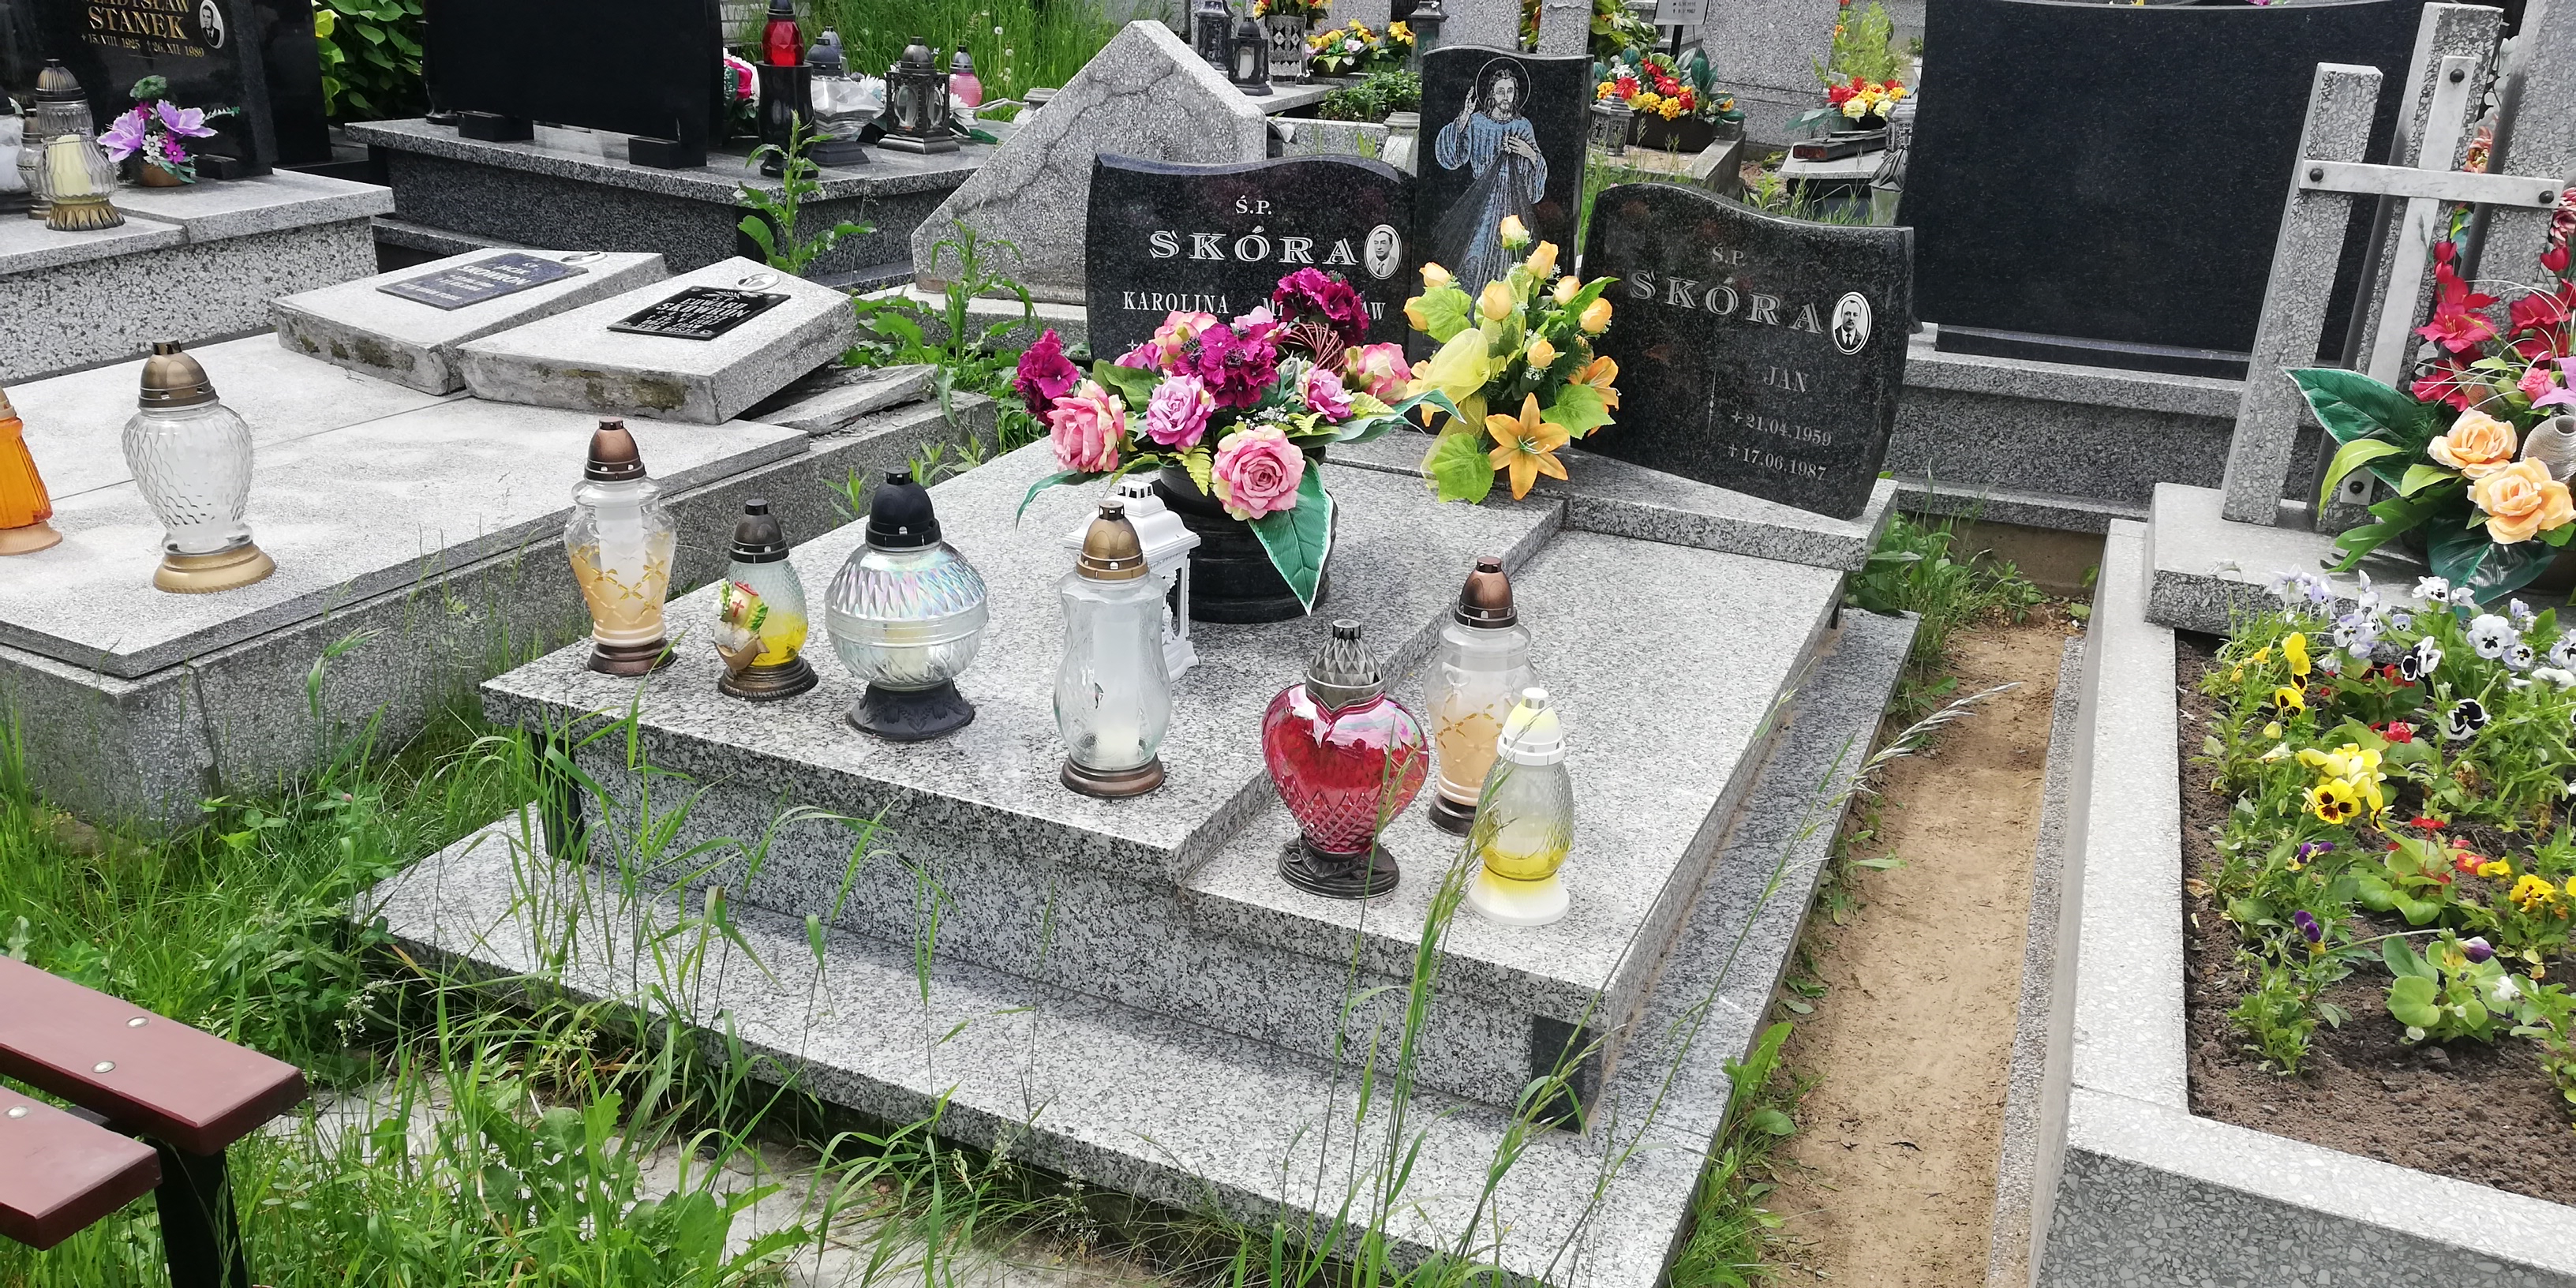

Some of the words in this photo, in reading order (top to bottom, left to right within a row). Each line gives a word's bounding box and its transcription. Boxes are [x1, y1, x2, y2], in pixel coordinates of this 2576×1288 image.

[88, 6, 188, 39] STANEK
[1235, 195, 1272, 215] Ś.P.
[1149, 225, 1359, 266] SKÓRA
[656, 303, 751, 317] SKOWRON
[680, 298, 748, 309] EDWARD
[1123, 291, 1229, 314] KAROLINA
[1630, 270, 1824, 334] SKÓRA
[1763, 365, 1810, 393] JAN
[1747, 414, 1832, 447] 21.04.1959
[1743, 447, 1827, 481] 17.06.1987
